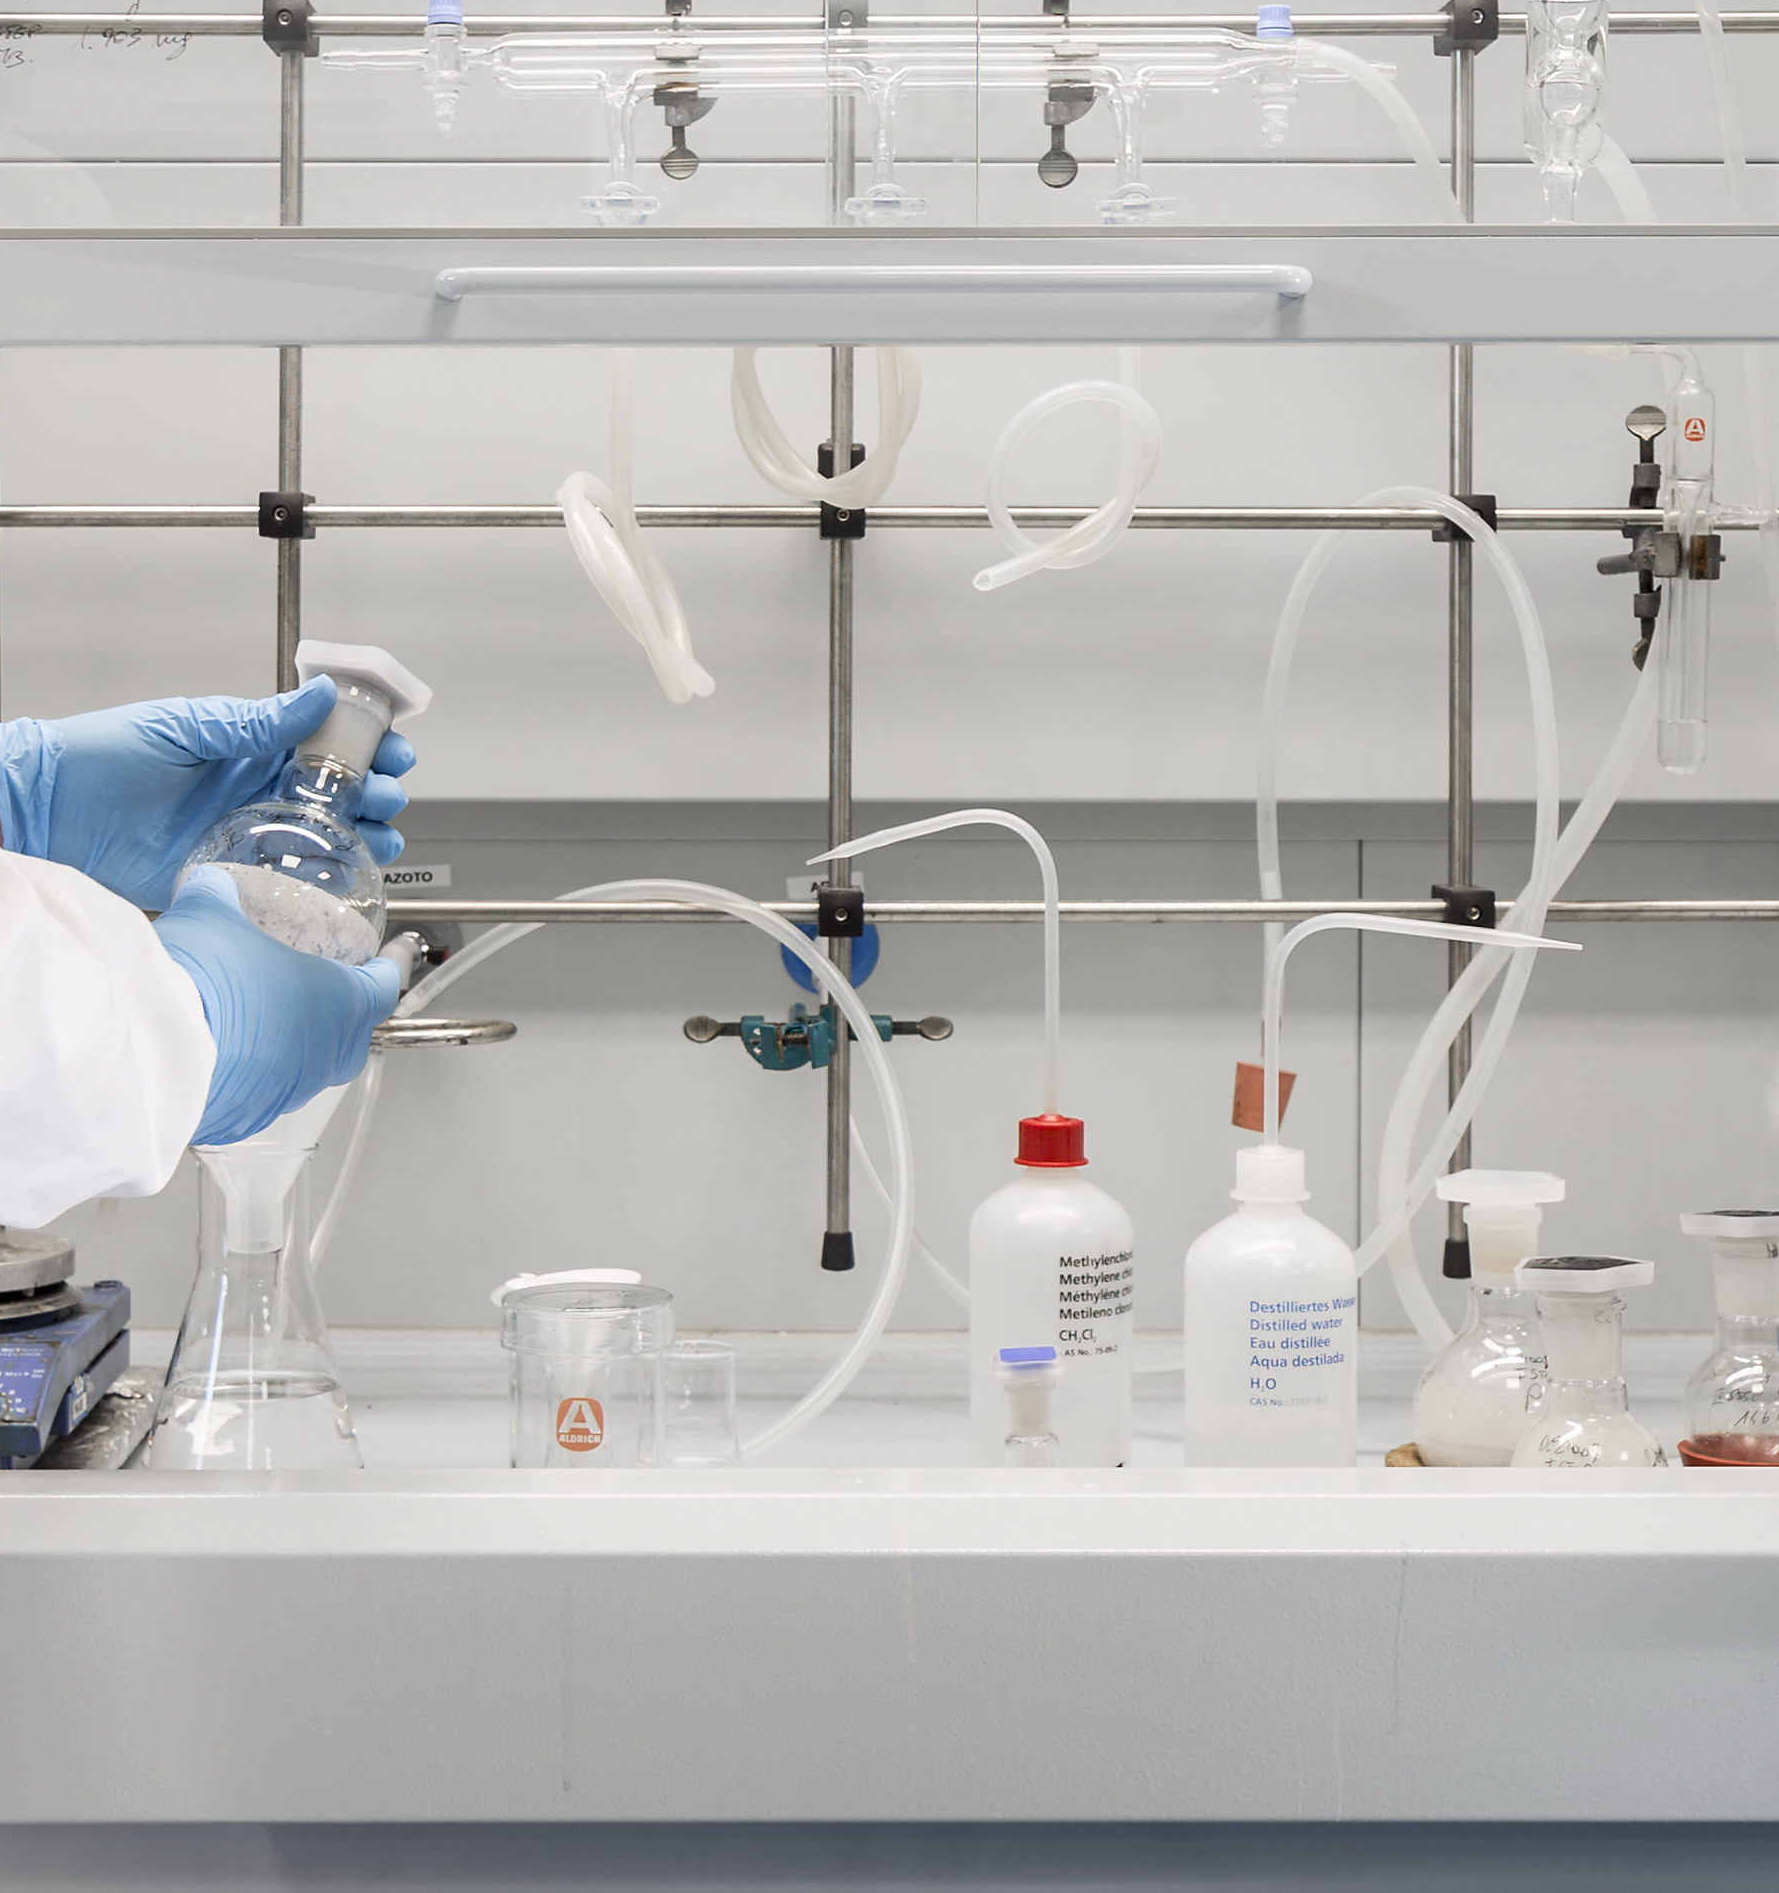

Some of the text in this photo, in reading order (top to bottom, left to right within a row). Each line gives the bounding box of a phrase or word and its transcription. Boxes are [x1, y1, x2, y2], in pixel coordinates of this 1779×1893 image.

[384, 872, 433, 884] AZOTO
[1059, 1271, 1121, 1287] Methylene
[1059, 1307, 1113, 1320] Metileno
[1249, 1300, 1329, 1314] Destilliertes
[1249, 1318, 1343, 1331] Distilled water
[1249, 1337, 1276, 1349] Eau
[1249, 1352, 1344, 1370] Aqua destilada
[1249, 1397, 1267, 1406] CAS
[558, 1433, 601, 1444] ALDRICH
